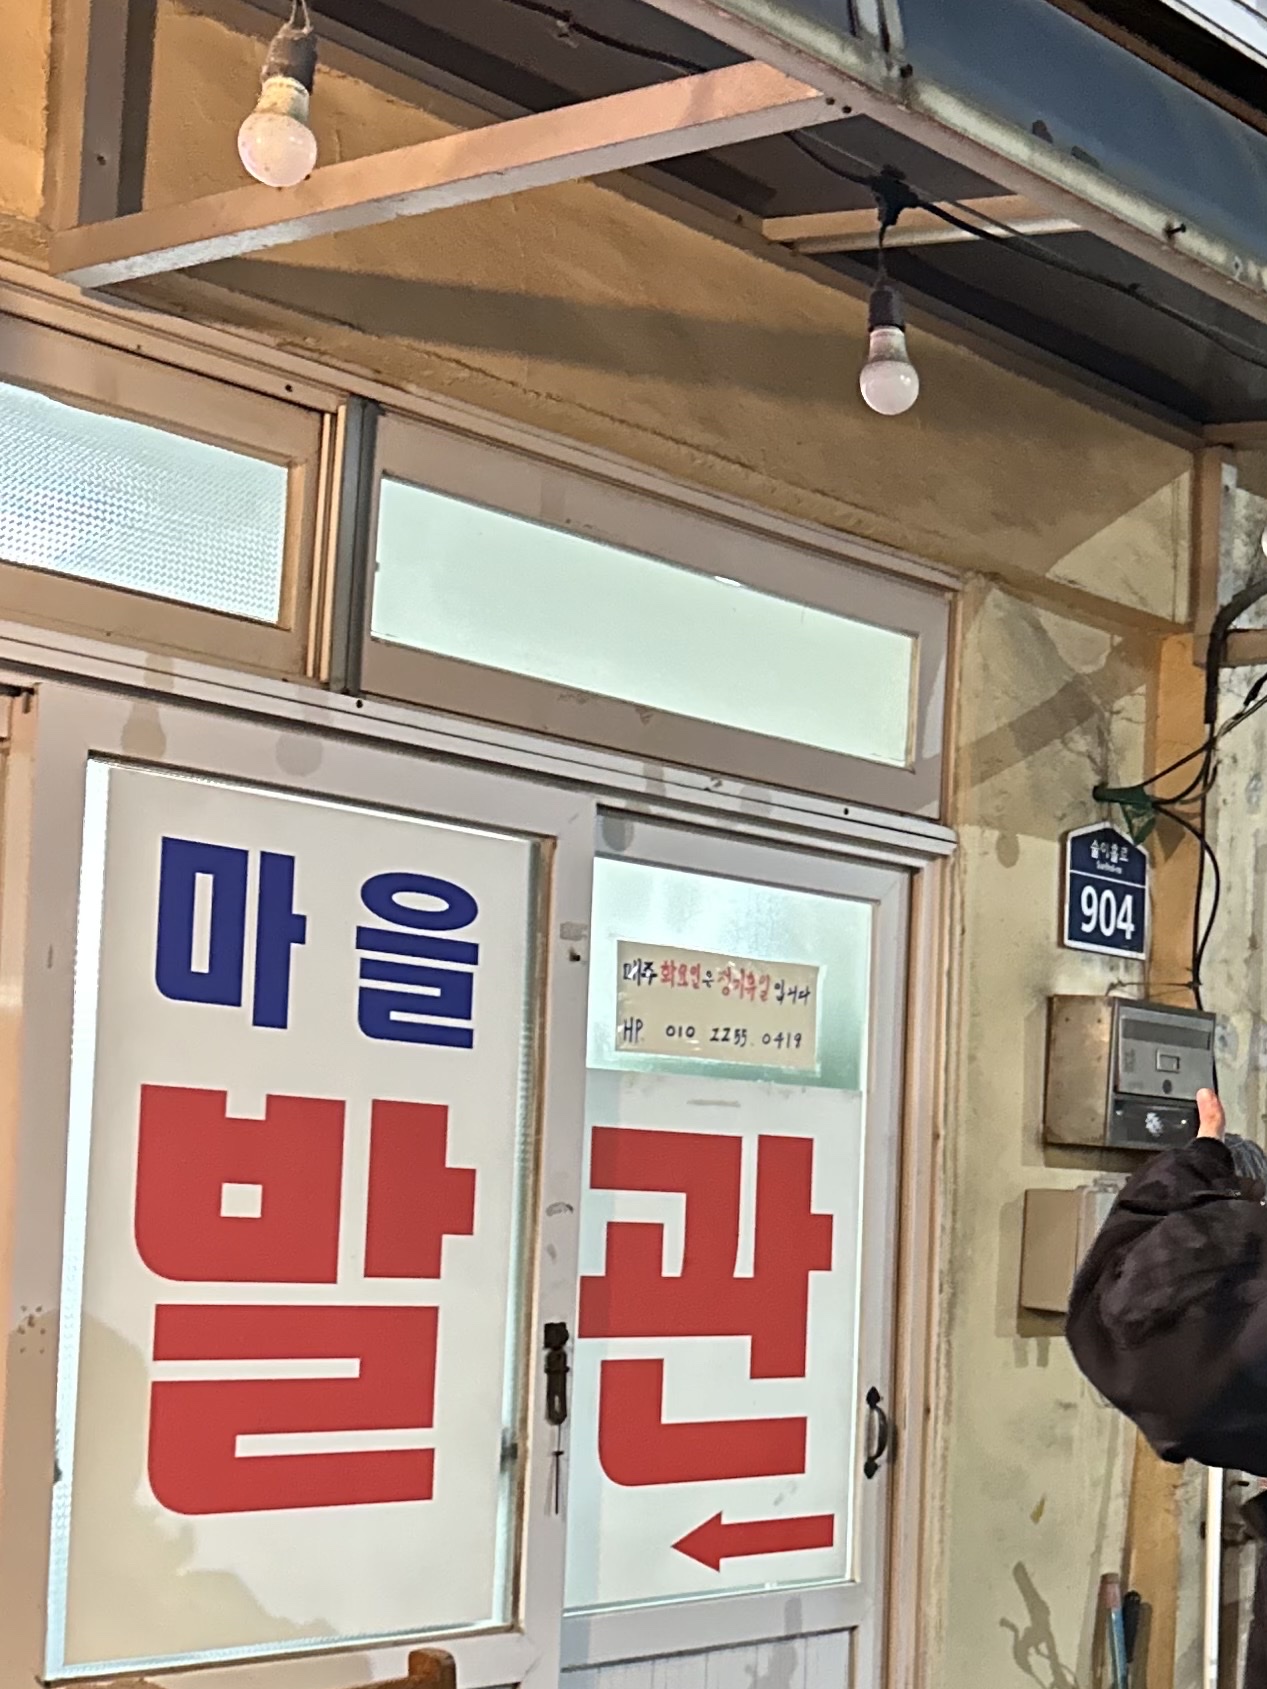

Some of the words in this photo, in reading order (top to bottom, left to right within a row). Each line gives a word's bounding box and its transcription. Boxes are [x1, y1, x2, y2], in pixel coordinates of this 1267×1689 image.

[1080, 885, 1135, 940] 904
[155, 836, 479, 1049] 마을
[623, 958, 658, 987] 매주
[665, 1024, 696, 1039] 010
[761, 1031, 803, 1050] 0419
